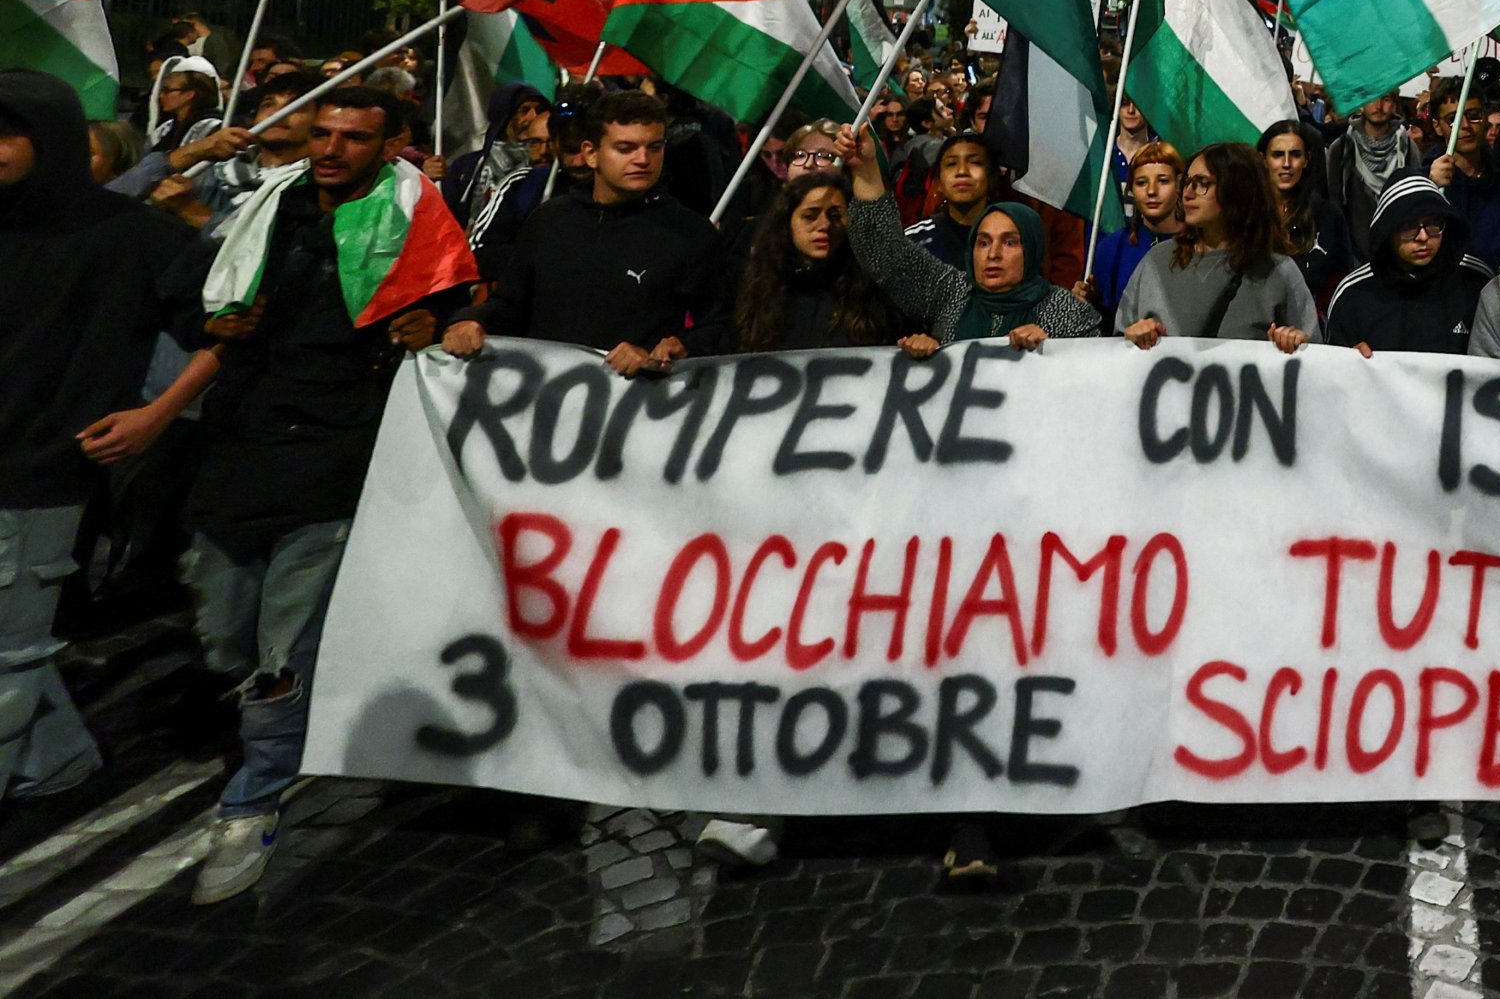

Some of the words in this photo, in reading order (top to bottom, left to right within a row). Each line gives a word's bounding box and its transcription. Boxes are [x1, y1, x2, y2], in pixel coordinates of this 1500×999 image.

[446, 338, 1026, 486] ROMPERE
[1136, 357, 1303, 468] CON
[499, 511, 1189, 669] BLOCCHIAMO
[414, 632, 518, 758] 3
[610, 673, 1082, 787] OTTOBRE
